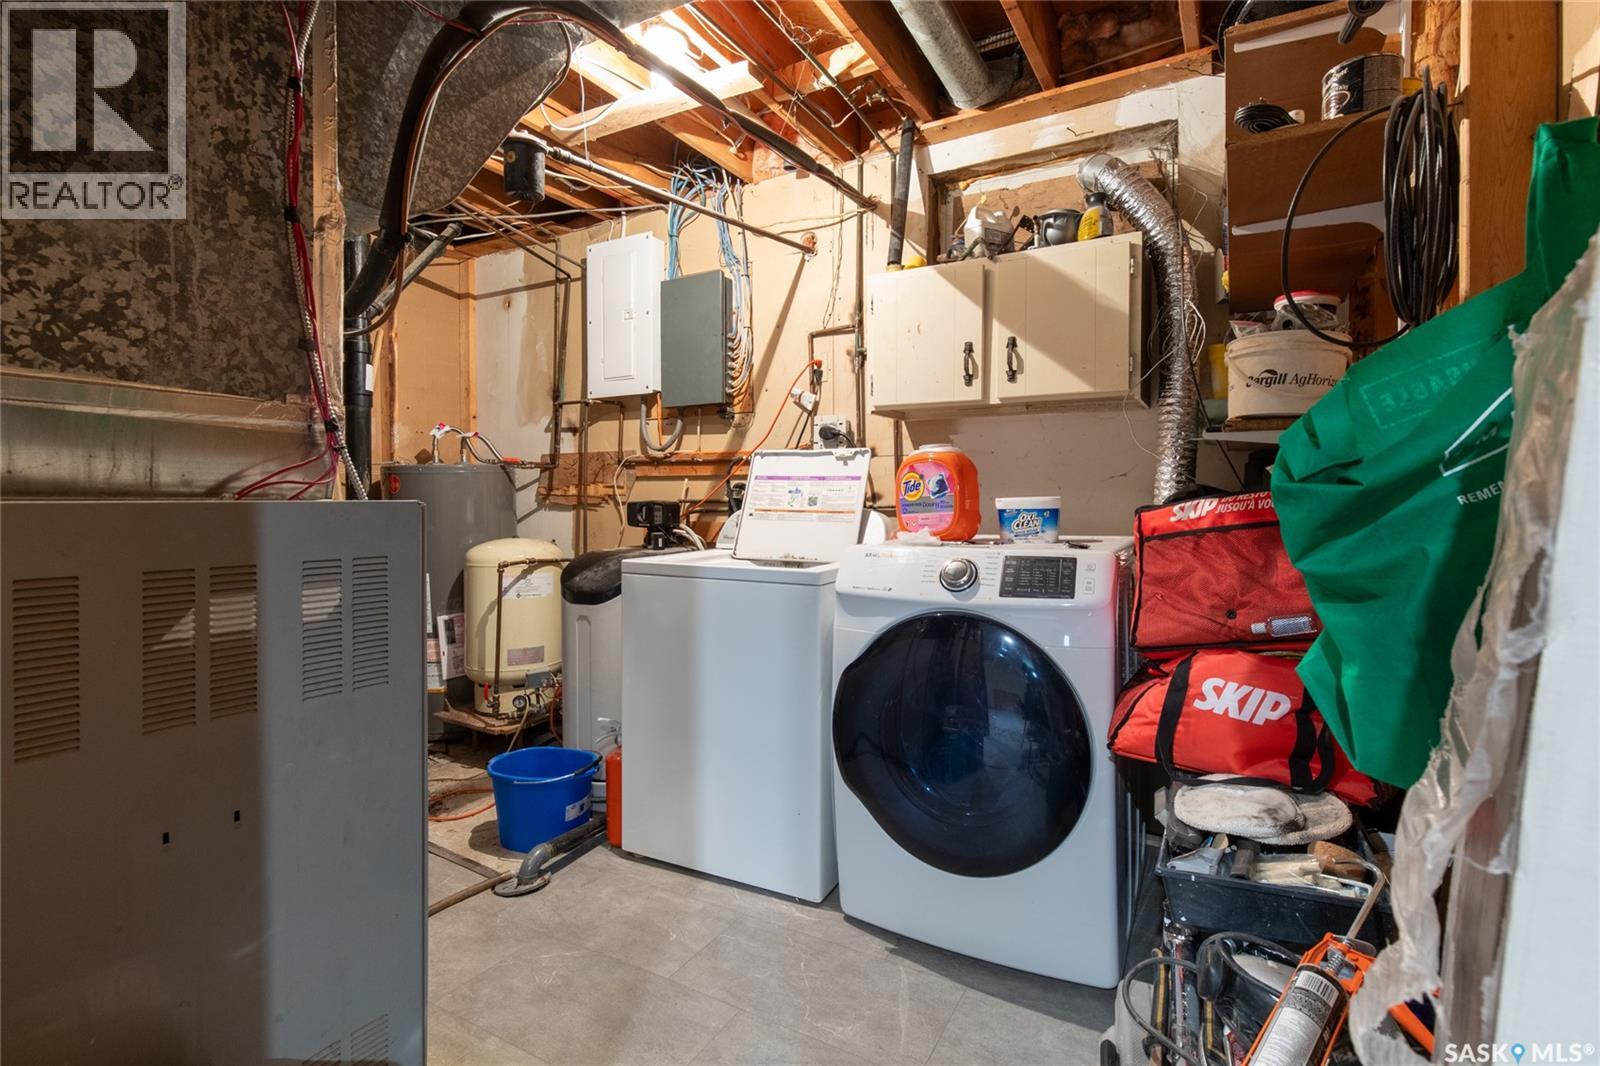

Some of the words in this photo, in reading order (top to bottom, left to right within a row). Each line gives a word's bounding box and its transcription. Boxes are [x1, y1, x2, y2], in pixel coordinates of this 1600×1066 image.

[1289, 373, 1338, 388] AgHoriz
[903, 479, 922, 497] Tide
[1169, 498, 1217, 522] SKIP
[1258, 498, 1274, 509] VO
[1193, 677, 1292, 726] SKIP
